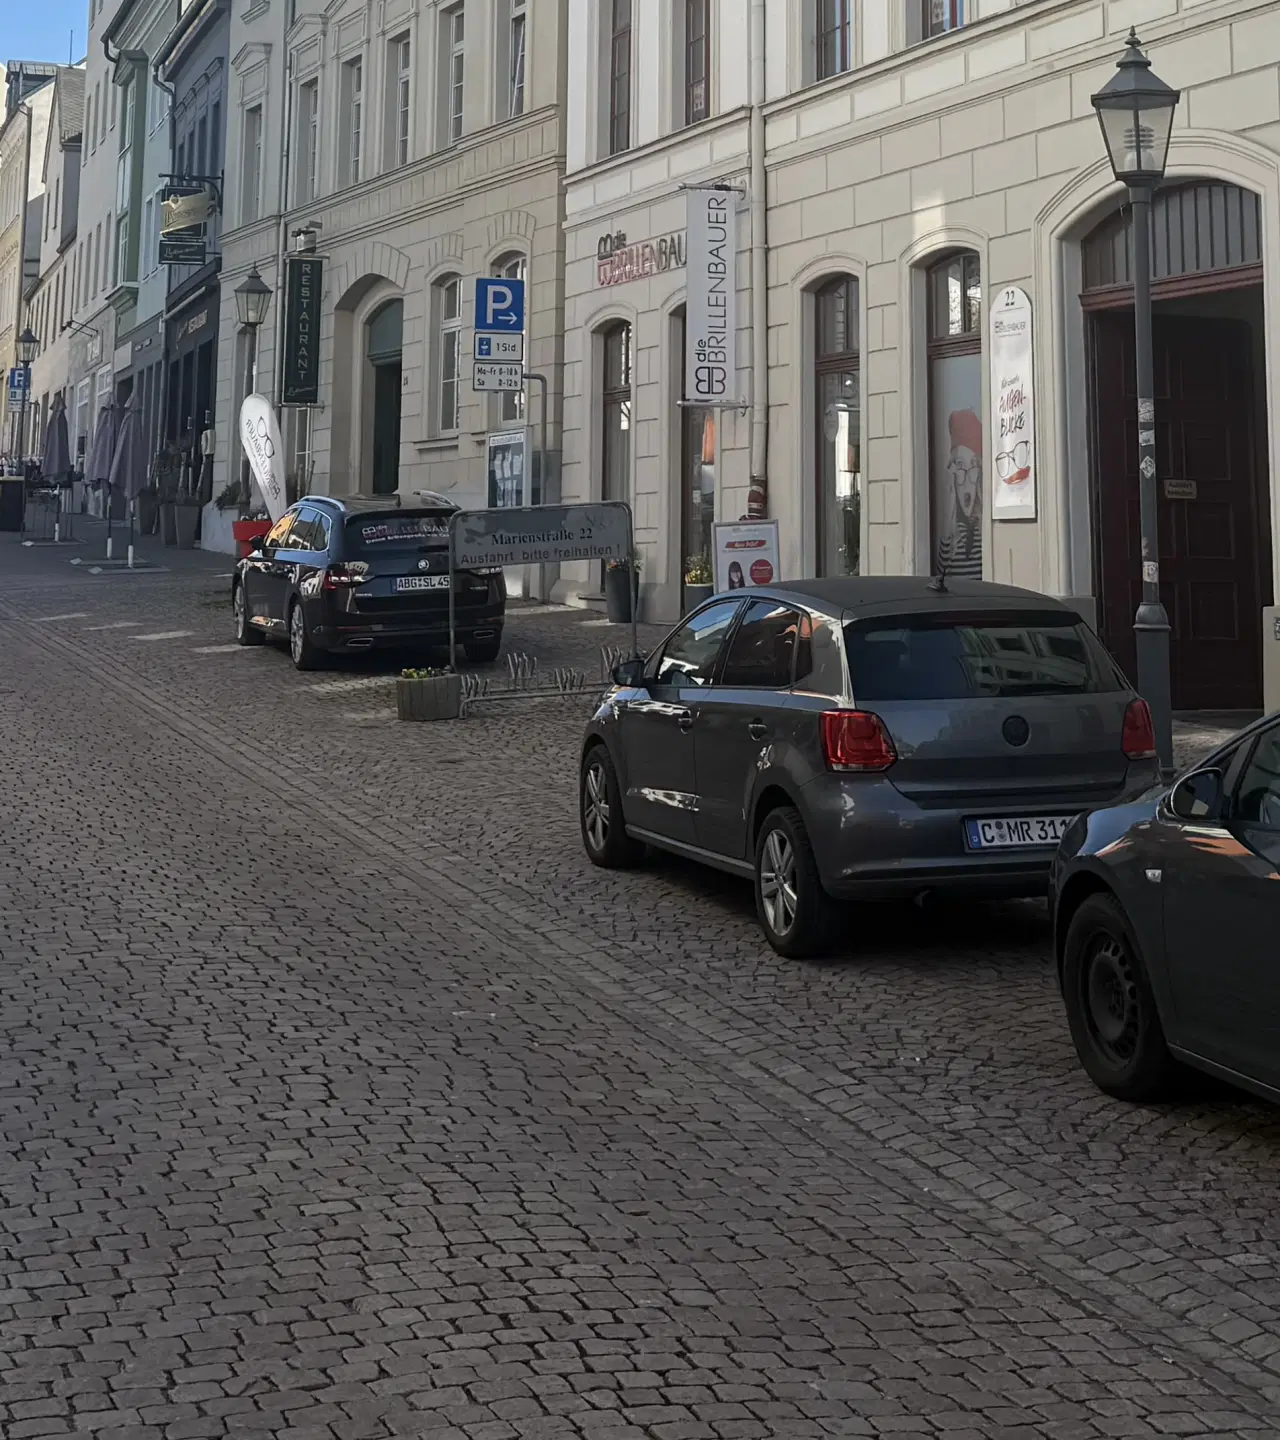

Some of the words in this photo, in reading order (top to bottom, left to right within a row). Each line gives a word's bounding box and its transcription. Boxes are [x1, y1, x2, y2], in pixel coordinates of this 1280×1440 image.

[612, 231, 688, 284] BRILLENBAU
[707, 197, 727, 363] BRILLENBAUER
[486, 285, 513, 324] P
[297, 263, 312, 381] RESTAURANT
[695, 339, 707, 363] die
[491, 529, 574, 546] Marienstraße
[579, 528, 593, 540] 22
[460, 551, 515, 564] Ausfahrt
[522, 549, 549, 560] bitte
[554, 545, 612, 558] freihalten
[398, 578, 417, 589] ABG
[981, 823, 995, 844] C
[1006, 820, 1034, 842] MR
